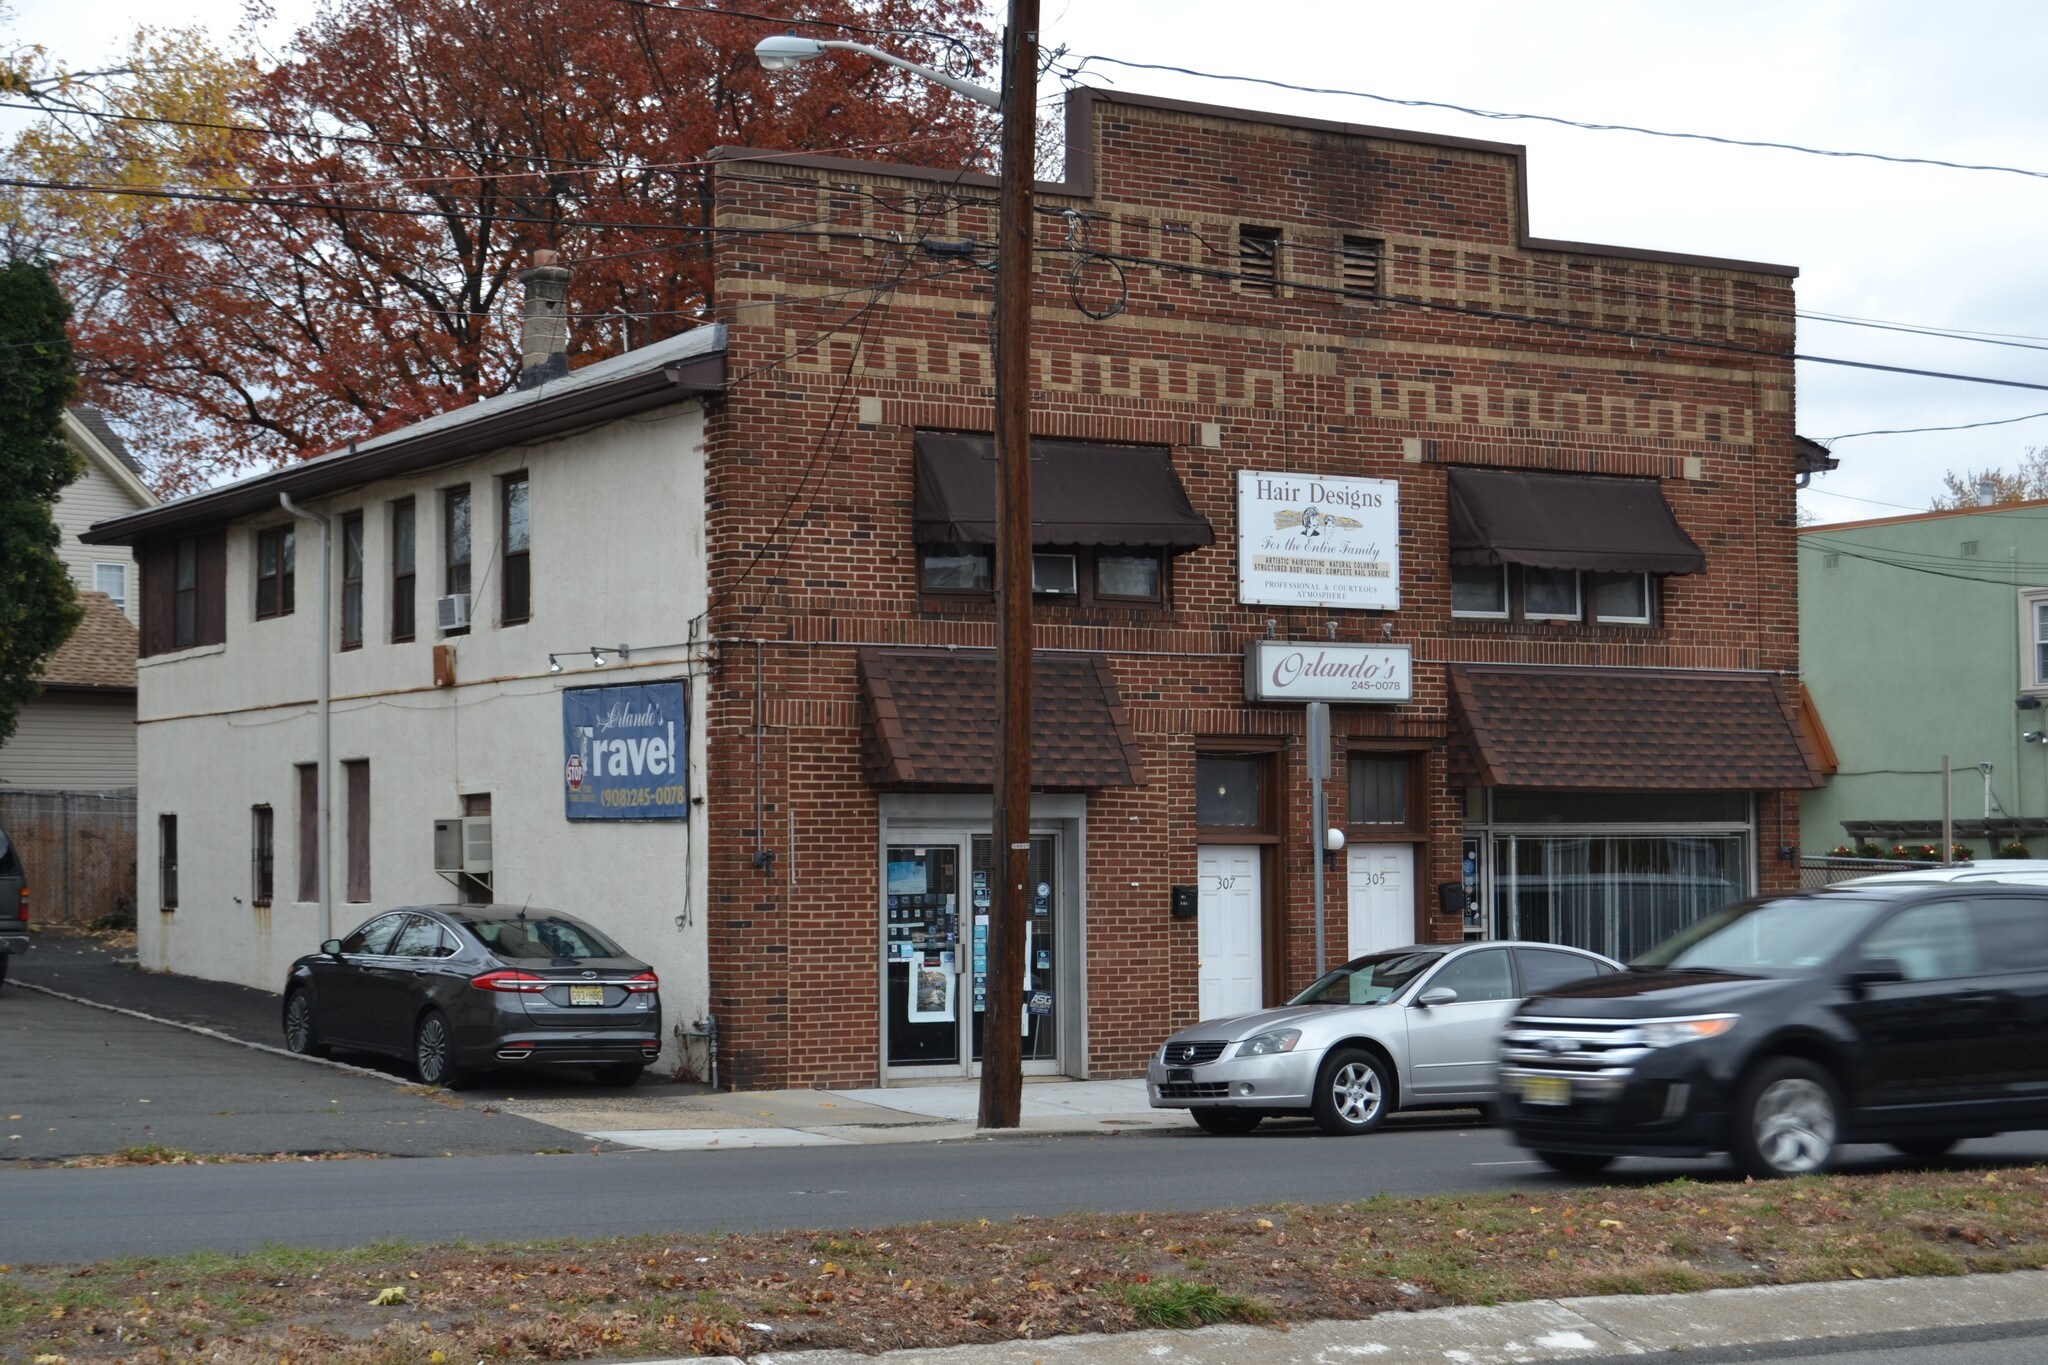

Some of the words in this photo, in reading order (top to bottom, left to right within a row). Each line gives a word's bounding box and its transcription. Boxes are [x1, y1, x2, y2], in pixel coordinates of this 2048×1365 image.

[1256, 480, 1300, 501] Hair
[1309, 482, 1382, 510] Designs
[1261, 535, 1280, 550] For
[1284, 537, 1301, 551] the
[1304, 538, 1336, 553] Entire
[1339, 540, 1380, 561] Family
[1254, 563, 1288, 572] STRUCTURED
[1290, 565, 1303, 573] BODY
[1305, 567, 1322, 575] WAVES
[1326, 568, 1352, 576] COMPLETE
[1354, 569, 1366, 577] NAIL
[1368, 570, 1389, 578] SERVICE
[1265, 557, 1289, 565] ARTISTIC
[1291, 558, 1325, 567] HAIRCUTTING
[1329, 560, 1352, 569] NATURAL
[1353, 562, 1379, 570] COLORING
[1264, 580, 1320, 590] PROFESSIONAL
[1333, 584, 1378, 593] COURTEOUS
[1297, 591, 1347, 600] ATMOSPHERE
[1272, 651, 1395, 688] Orlando's
[1351, 681, 1400, 690] 245-0078
[603, 701, 664, 731] Orlando's
[573, 721, 675, 776] Travel
[567, 766, 583, 781] STOP
[601, 785, 684, 807] (908)245-0078
[1216, 877, 1236, 890] 307
[1366, 873, 1385, 885] 305
[1030, 994, 1052, 1005] ASG
